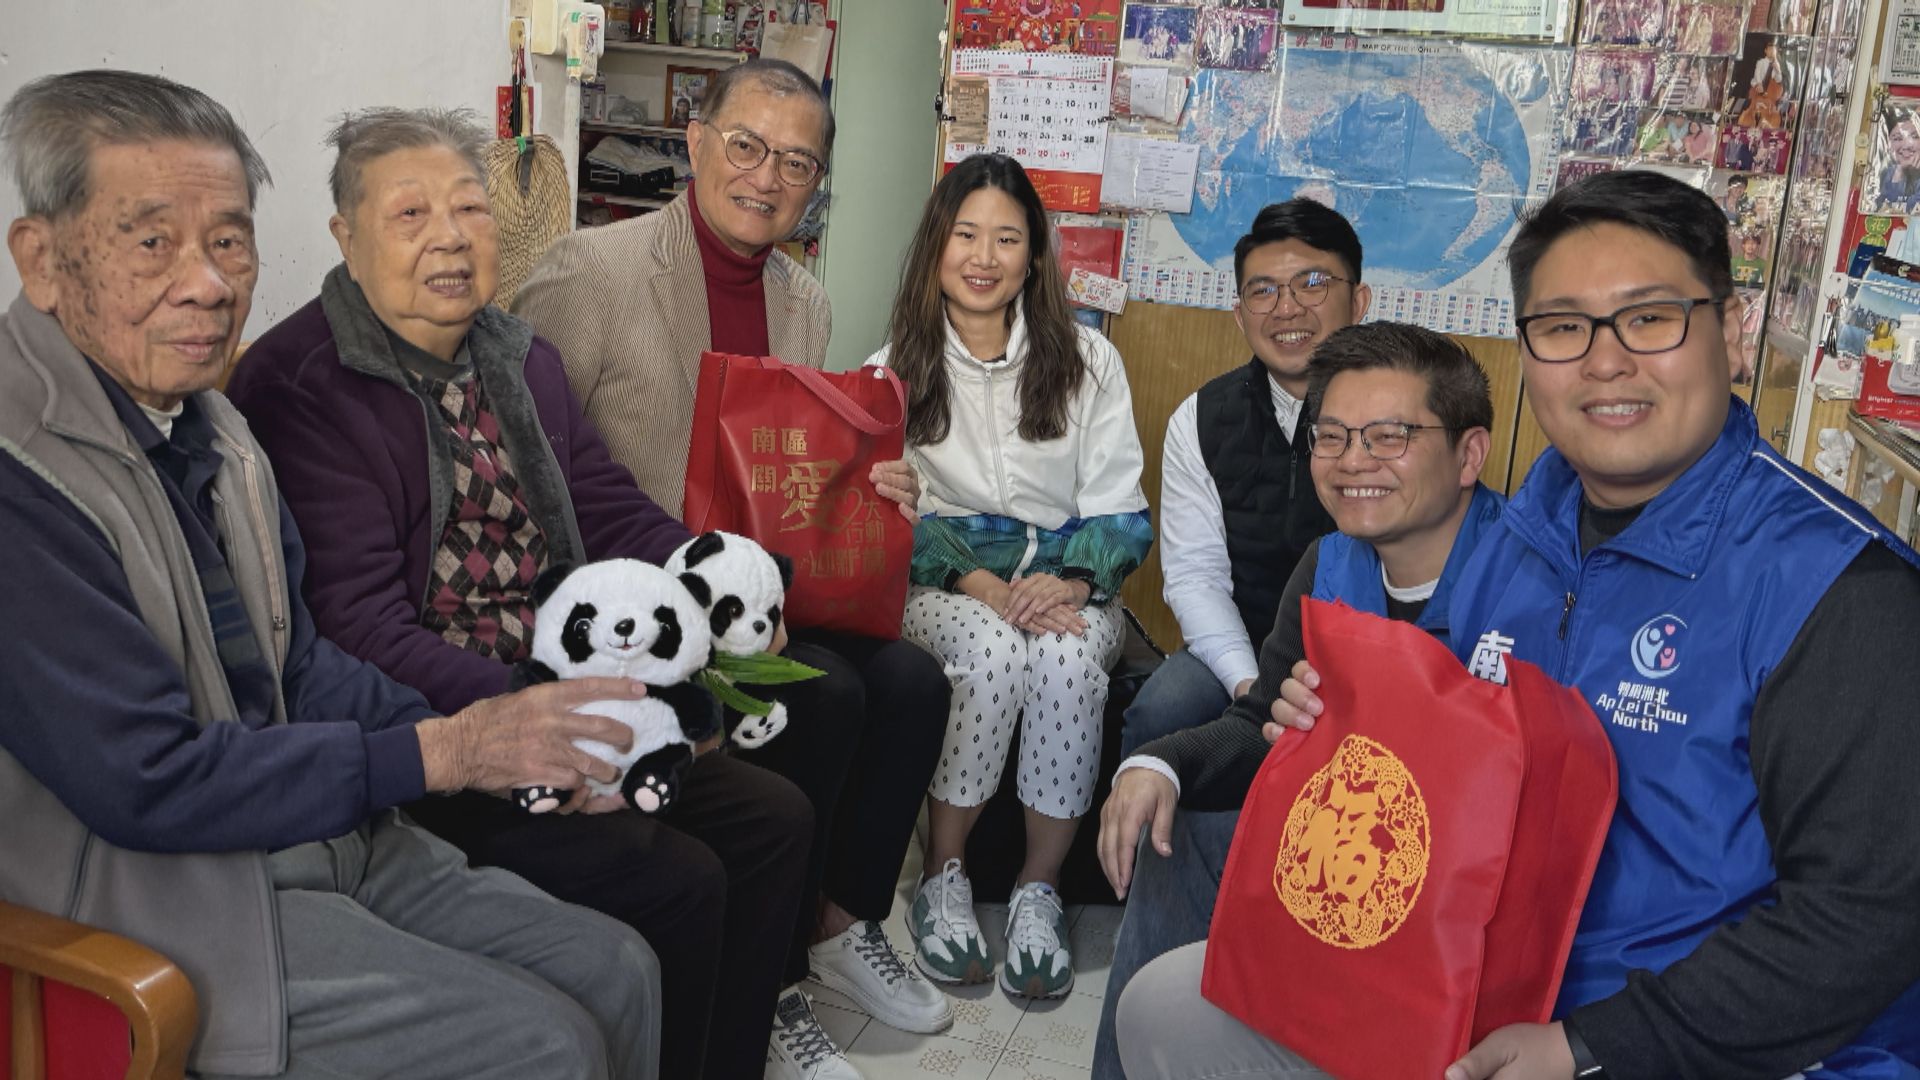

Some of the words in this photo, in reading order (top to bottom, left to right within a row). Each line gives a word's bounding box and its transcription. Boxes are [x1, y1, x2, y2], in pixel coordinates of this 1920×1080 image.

[752, 426, 807, 456] 南區
[1468, 630, 1514, 685] 南
[1596, 693, 1616, 711] Ap
[1618, 697, 1640, 713] Lei
[1643, 701, 1688, 725] Chau
[1612, 710, 1659, 733] North
[1297, 774, 1384, 902] 福
